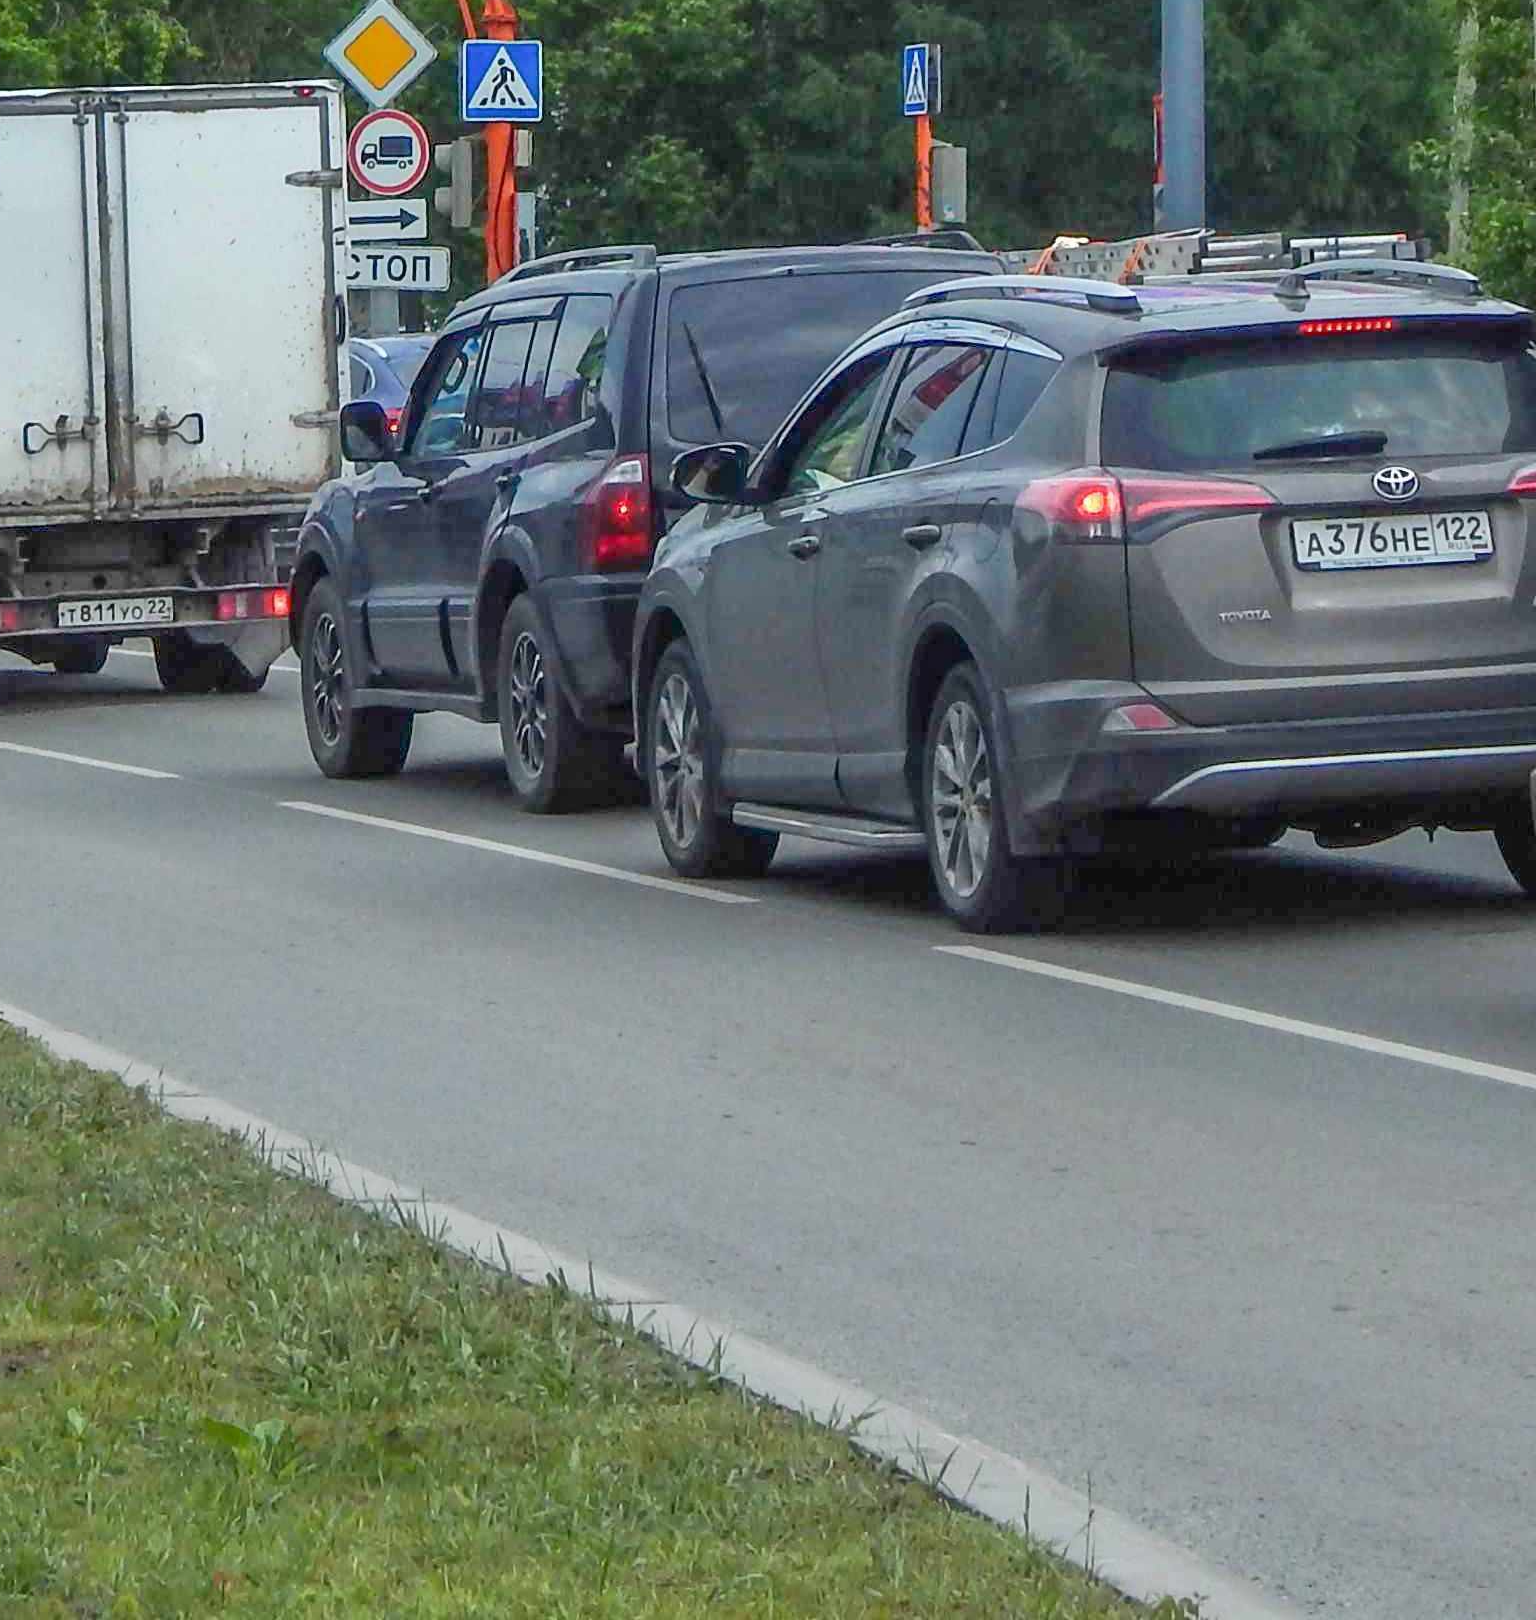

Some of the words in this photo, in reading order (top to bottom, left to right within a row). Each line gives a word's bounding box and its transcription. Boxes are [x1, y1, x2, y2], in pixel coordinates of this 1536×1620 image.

[1436, 516, 1483, 541] 122
[147, 599, 167, 614] 22
[1218, 609, 1273, 623] TOYOTA
